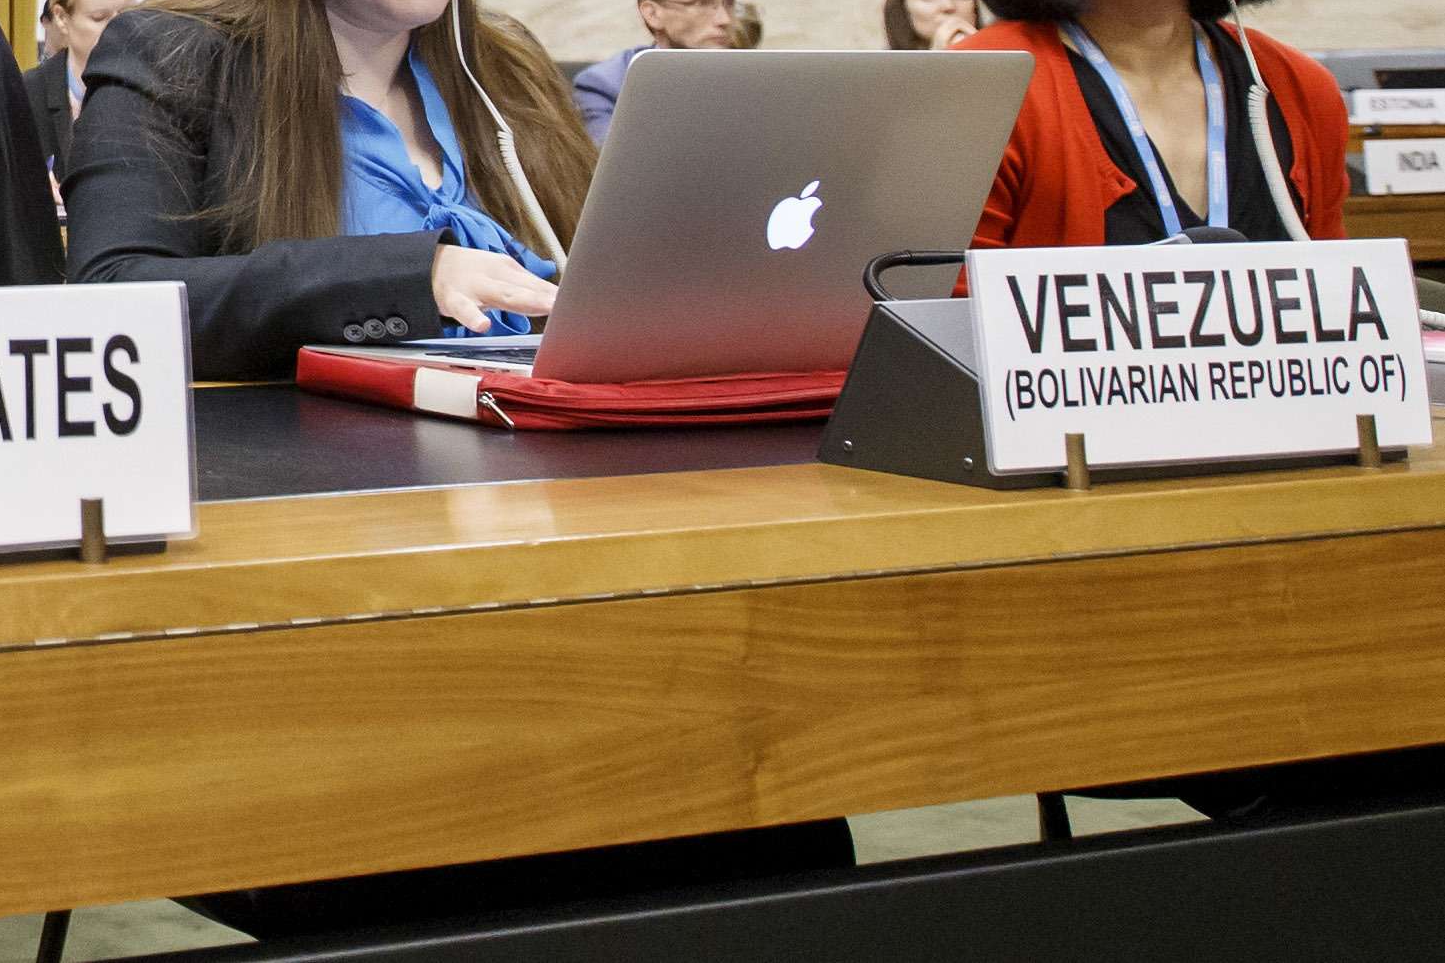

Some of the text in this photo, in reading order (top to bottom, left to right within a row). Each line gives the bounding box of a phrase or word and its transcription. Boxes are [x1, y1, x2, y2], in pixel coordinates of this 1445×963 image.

[1005, 266, 1390, 354] VENEZUELA
[1004, 353, 1407, 422] (BOLIVARIAN REPUBLIC OF)
